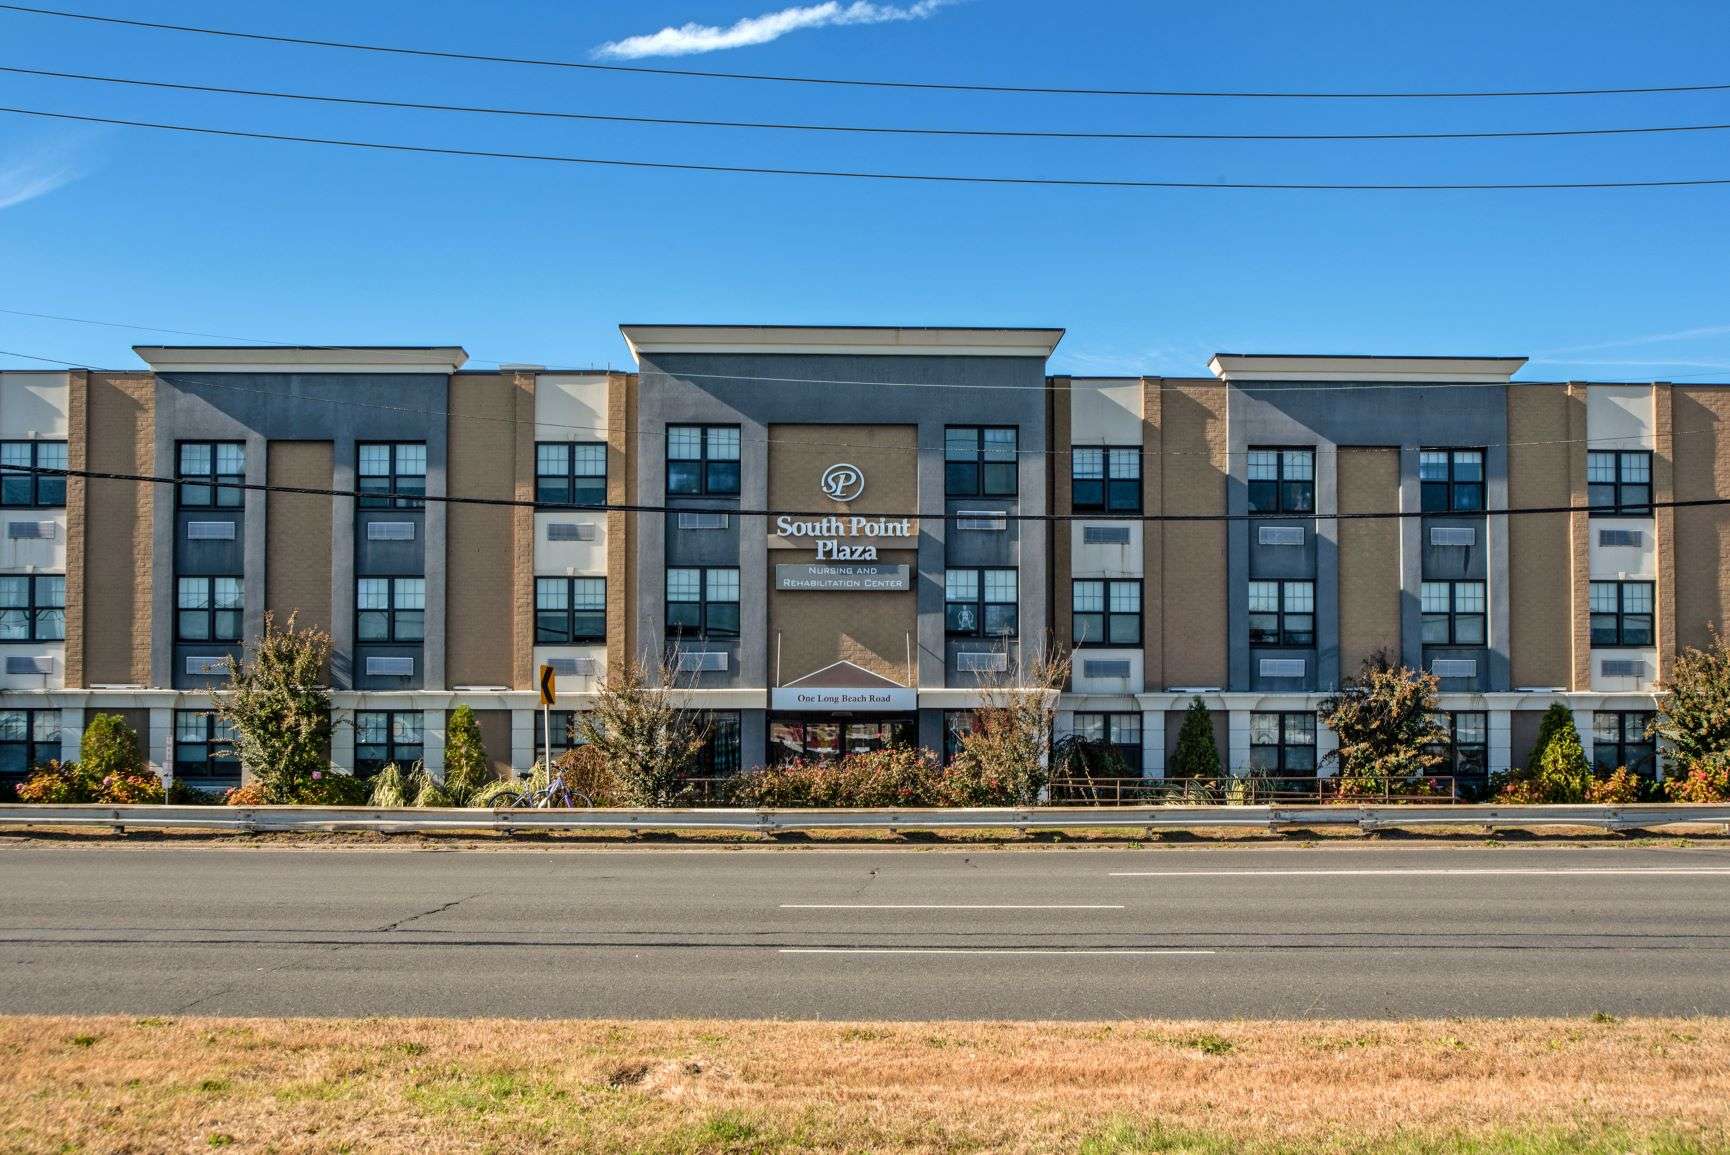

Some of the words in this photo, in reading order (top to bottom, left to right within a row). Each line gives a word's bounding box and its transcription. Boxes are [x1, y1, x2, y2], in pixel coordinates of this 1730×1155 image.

[776, 516, 845, 537] South
[849, 516, 911, 537] Point
[815, 540, 877, 560] Plaza
[797, 694, 815, 703] One
[817, 694, 840, 704] Long
[842, 694, 867, 703] Beach
[869, 694, 891, 703] Road
